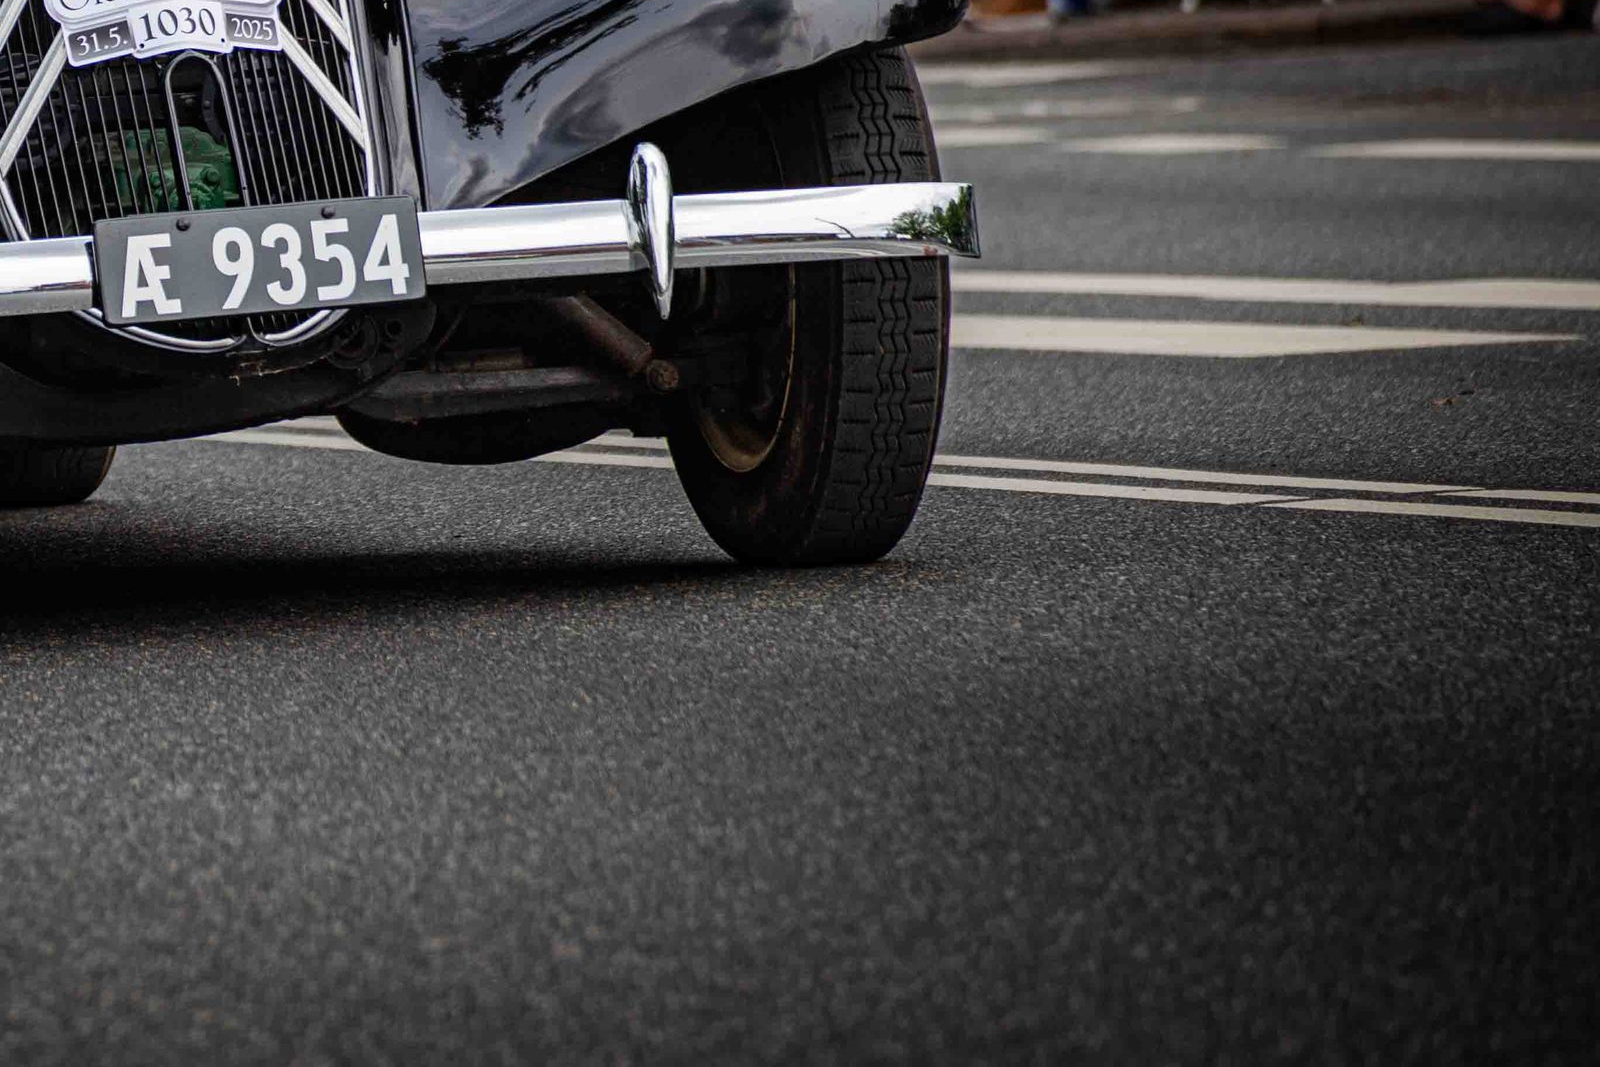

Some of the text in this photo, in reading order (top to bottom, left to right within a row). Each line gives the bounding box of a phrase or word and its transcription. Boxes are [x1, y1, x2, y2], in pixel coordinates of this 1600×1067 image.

[139, 7, 216, 42] 1030
[231, 18, 274, 41] 2025
[76, 28, 129, 56] 31.5.
[121, 214, 410, 318] Æ 9354
